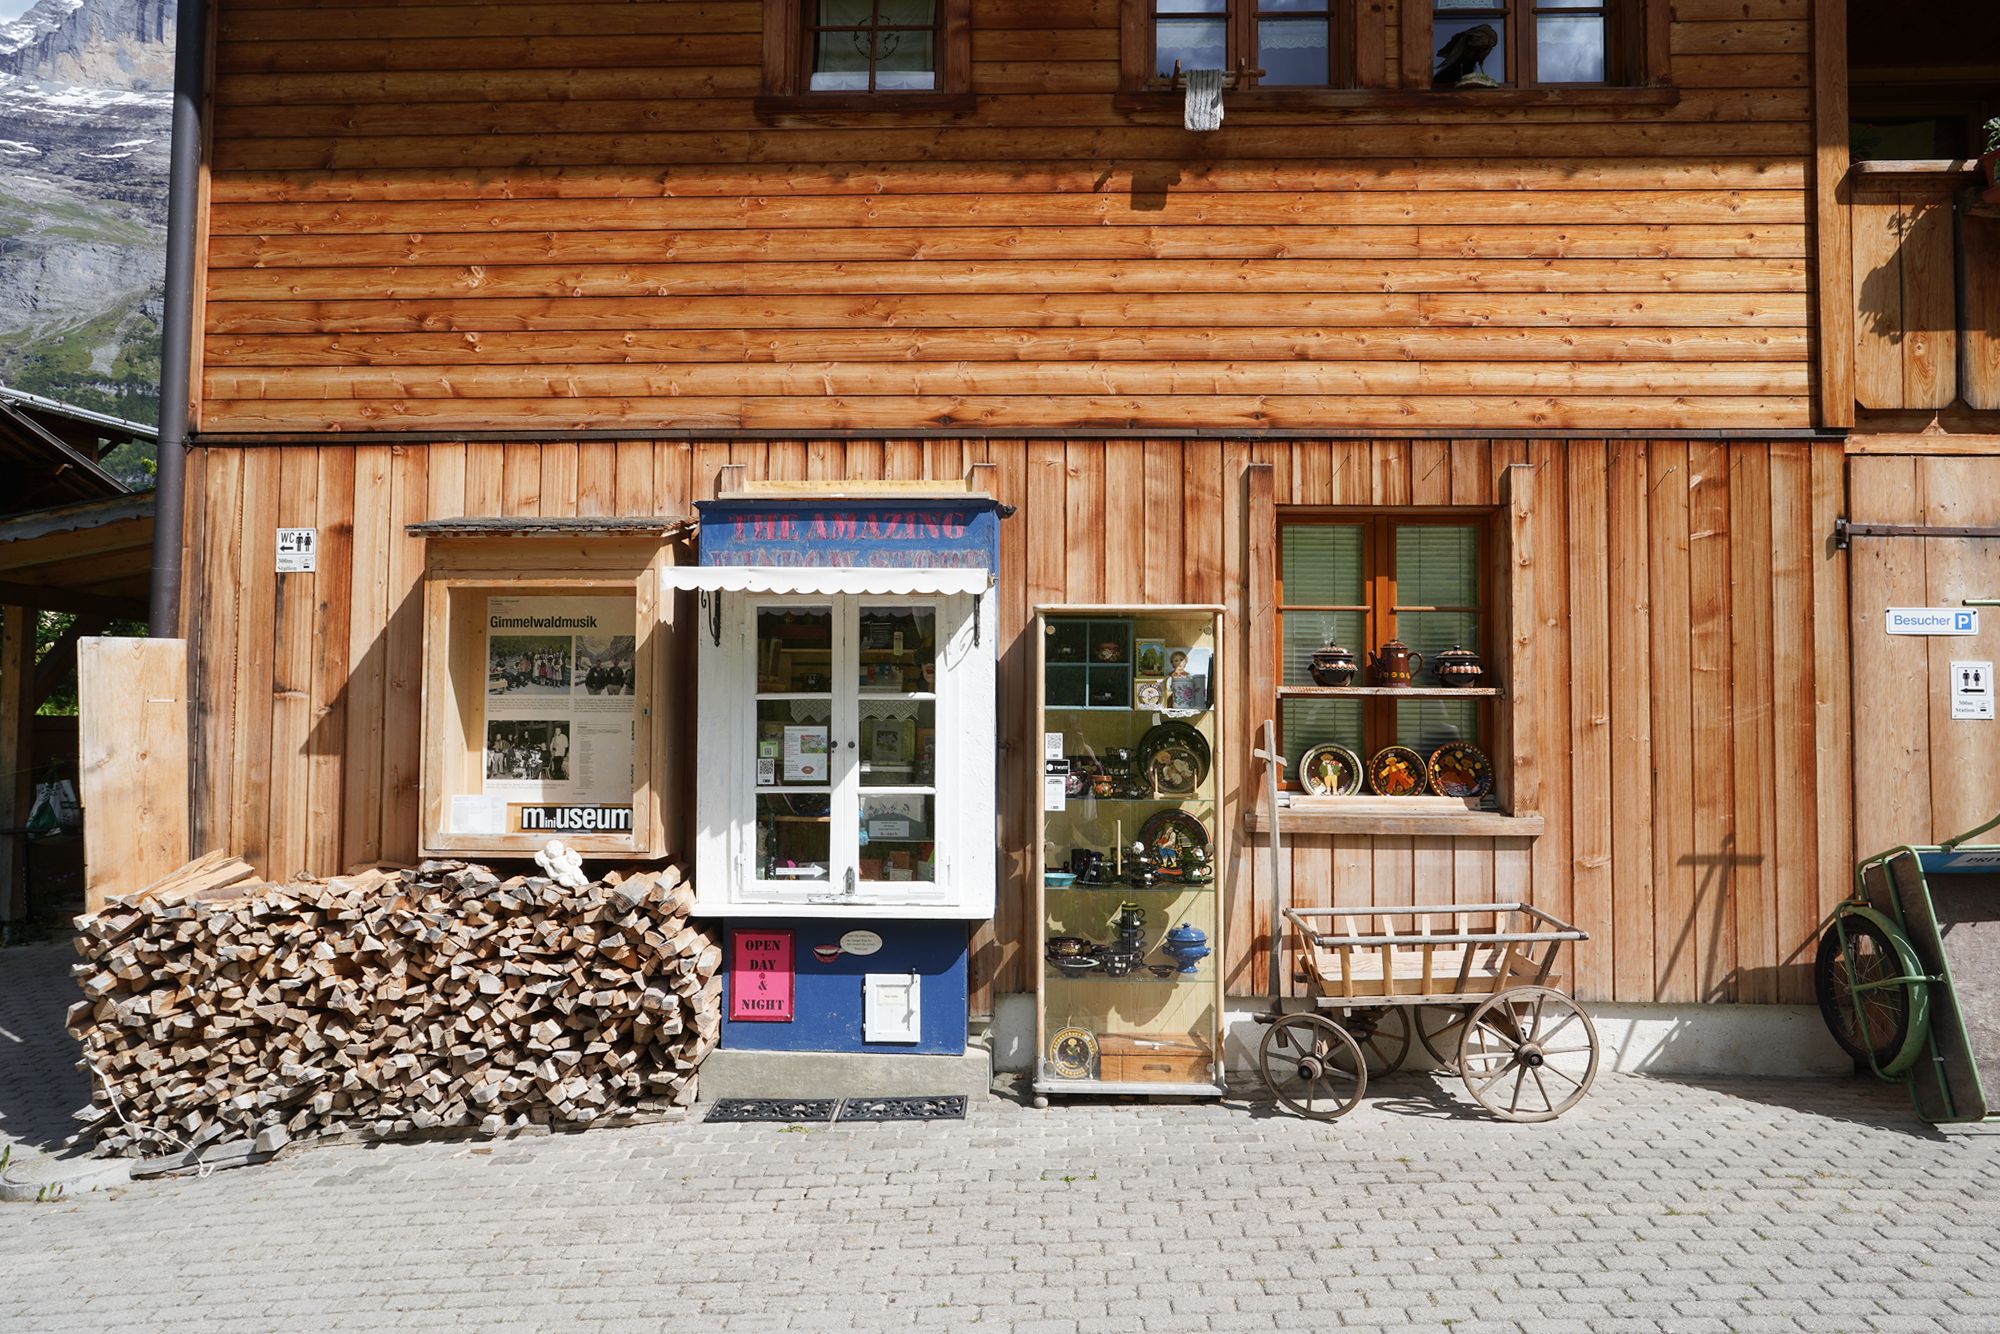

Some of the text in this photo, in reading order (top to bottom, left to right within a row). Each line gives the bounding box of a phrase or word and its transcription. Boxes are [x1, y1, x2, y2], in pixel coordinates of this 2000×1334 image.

[730, 511, 966, 541] THE AMAZING
[280, 532, 295, 543] WC
[490, 615, 598, 628] Gimmelwaldmusik
[1894, 615, 1951, 626] Besucher
[745, 939, 781, 951] OPEN
[749, 959, 776, 970] DAY
[758, 980, 767, 991] &
[741, 999, 784, 1010] NIGHT
